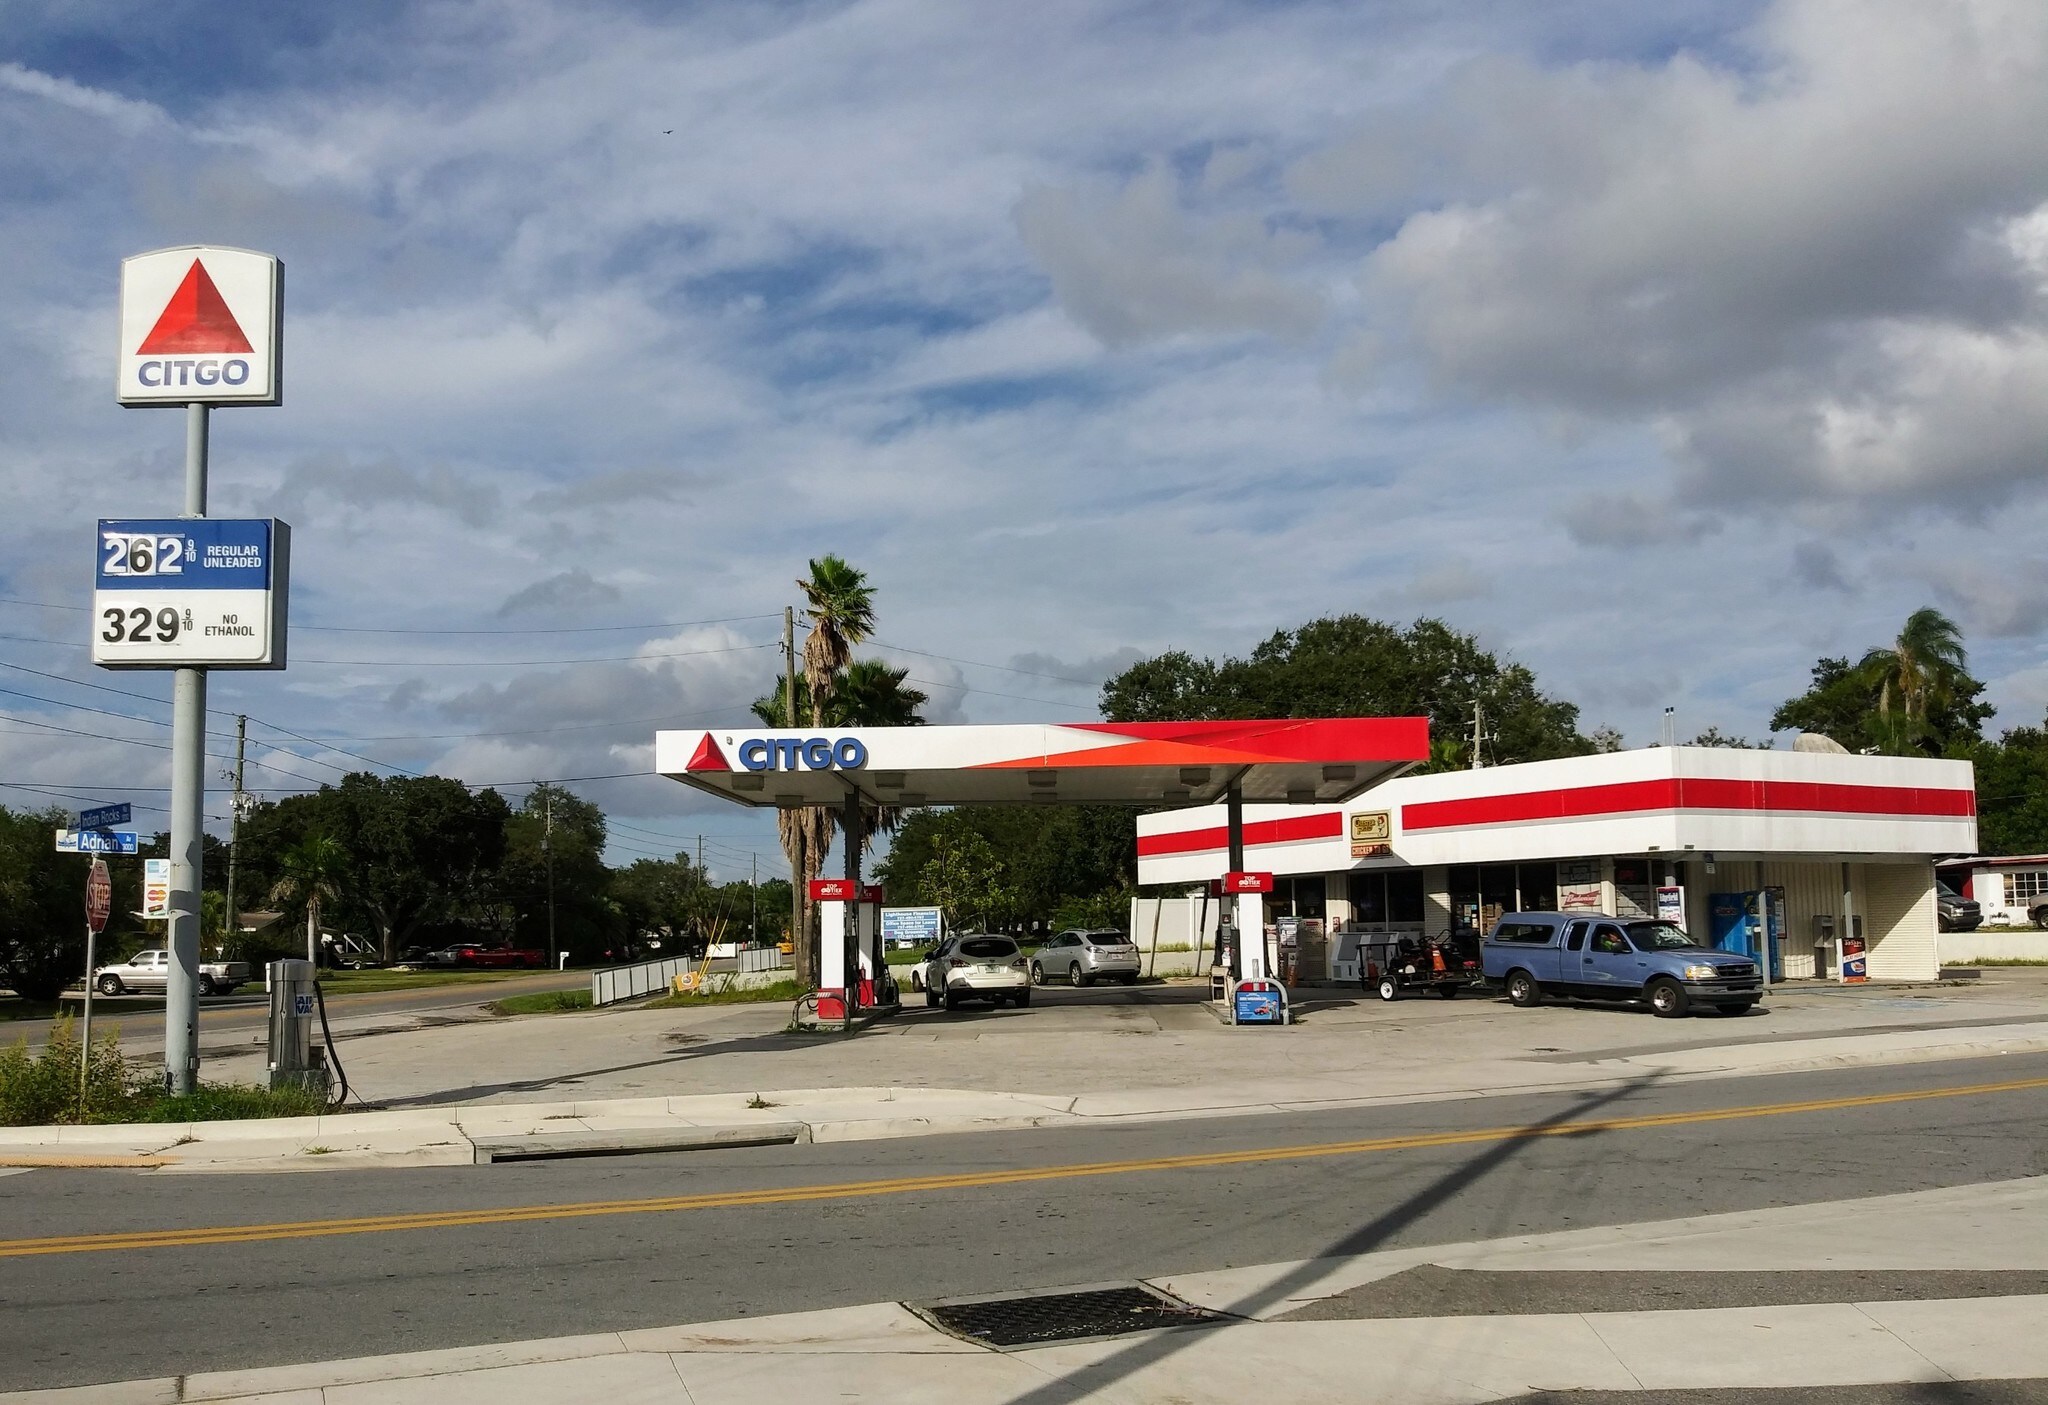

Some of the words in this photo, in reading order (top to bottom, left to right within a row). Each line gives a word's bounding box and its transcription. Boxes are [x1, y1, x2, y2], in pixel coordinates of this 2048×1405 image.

[138, 359, 250, 387] CITGO
[103, 537, 184, 573] 262
[207, 545, 259, 557] REGULAR
[203, 557, 262, 568] UNLEADED
[102, 607, 180, 643] 329
[222, 614, 238, 624] NO
[204, 625, 255, 636] ETHANOL
[738, 737, 866, 771] CITGO
[82, 812, 100, 827] Indian
[101, 809, 121, 824] Rocks
[80, 833, 119, 850] Adrian
[88, 883, 110, 910] STOP
[1567, 891, 1599, 903] Budweiser
